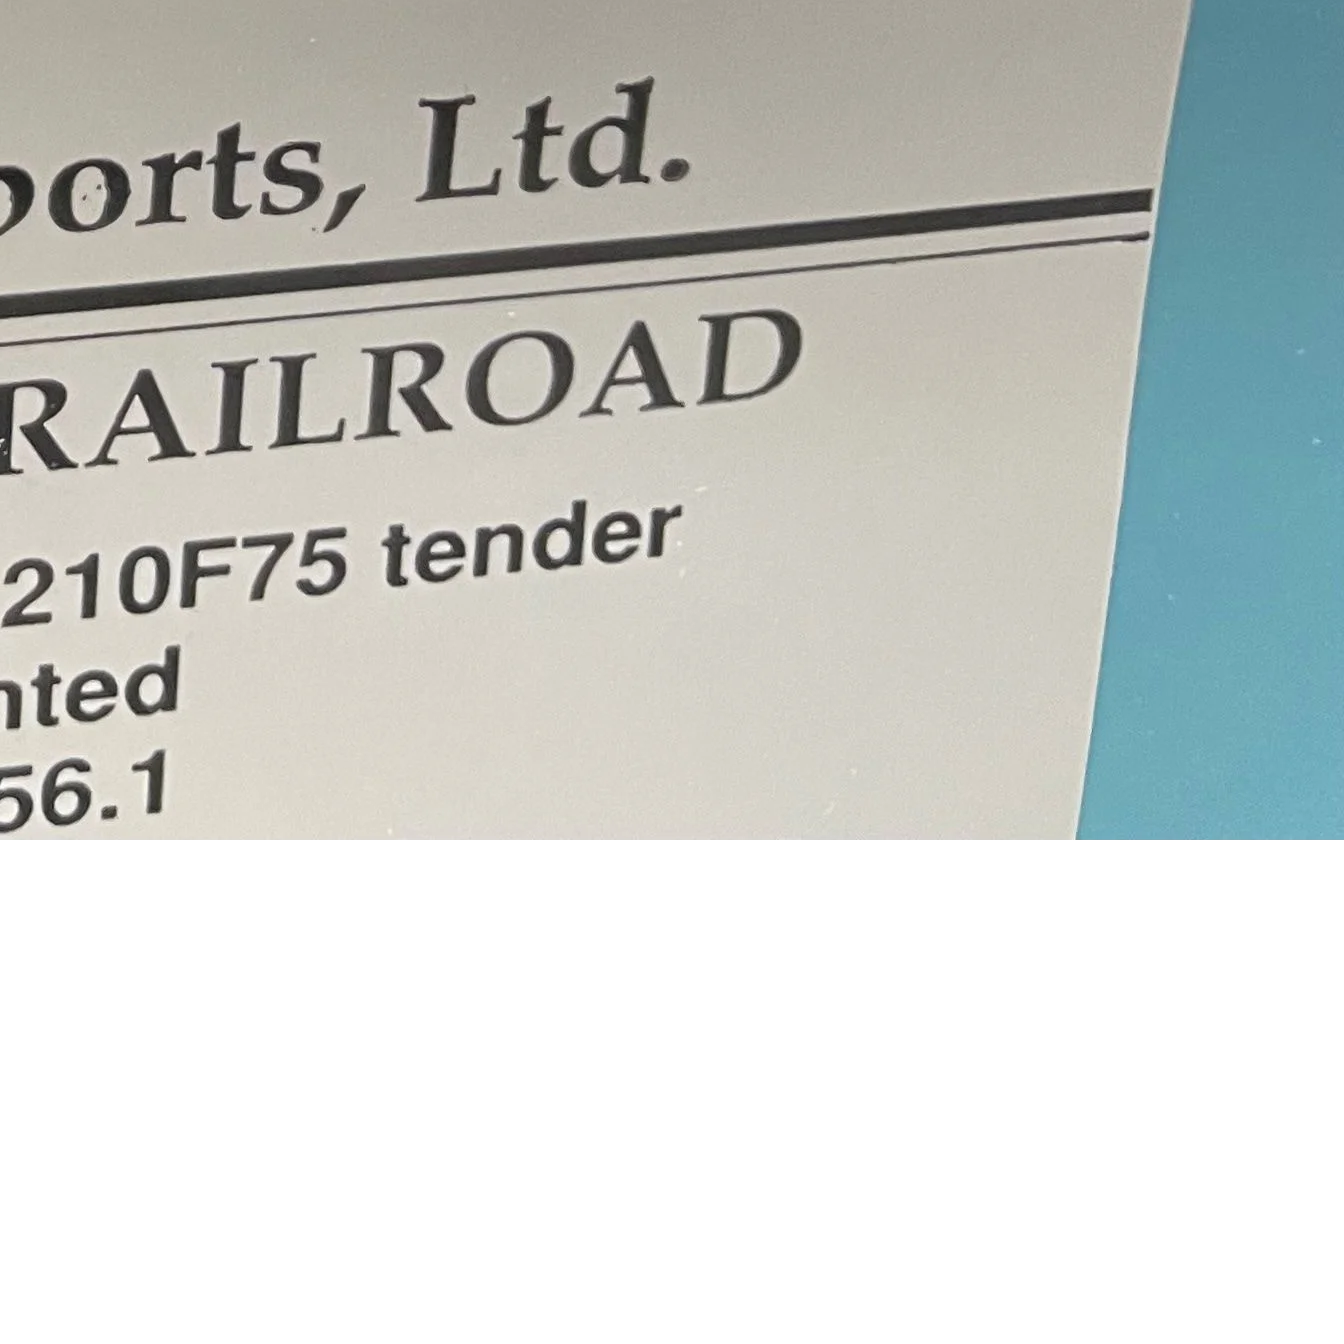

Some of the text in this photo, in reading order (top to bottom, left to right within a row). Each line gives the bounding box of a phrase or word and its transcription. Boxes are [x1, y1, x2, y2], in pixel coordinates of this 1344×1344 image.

[414, 75, 691, 204] Ltd.
[0, 526, 348, 629] 210F75
[380, 499, 683, 588] tender
